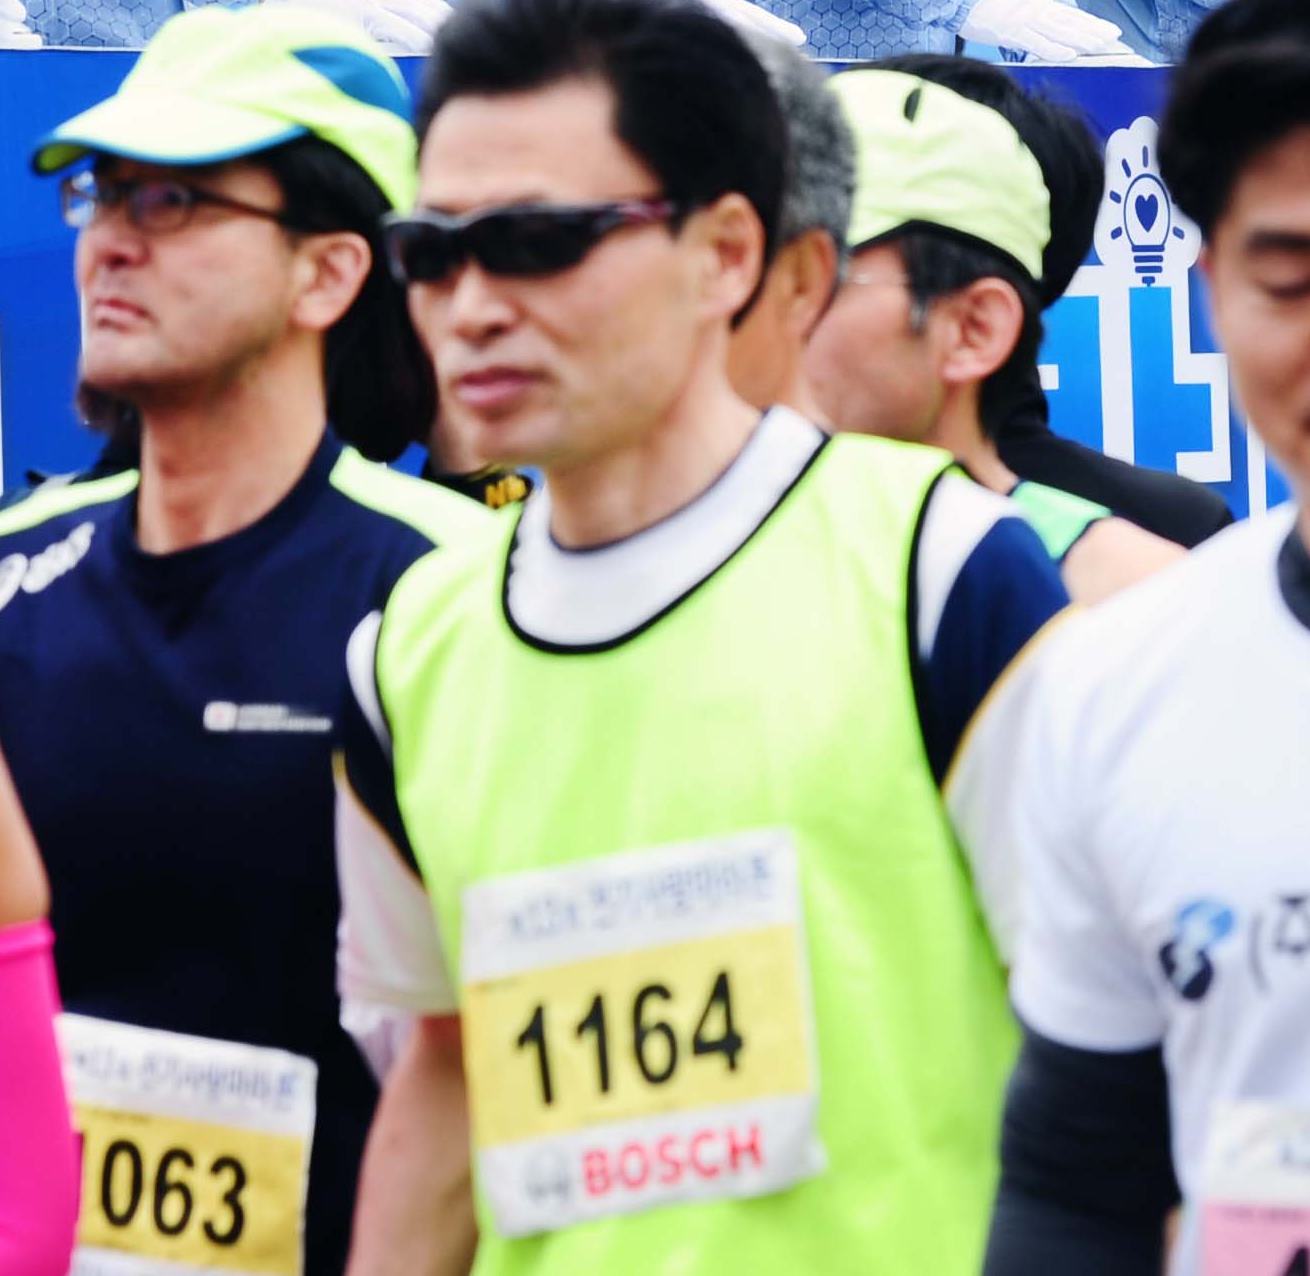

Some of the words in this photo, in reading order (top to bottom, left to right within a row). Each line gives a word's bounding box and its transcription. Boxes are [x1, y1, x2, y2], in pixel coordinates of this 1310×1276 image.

[516, 970, 744, 1106] 1164
[78, 1134, 249, 1247] 063
[582, 1121, 766, 1198] BOSCH
